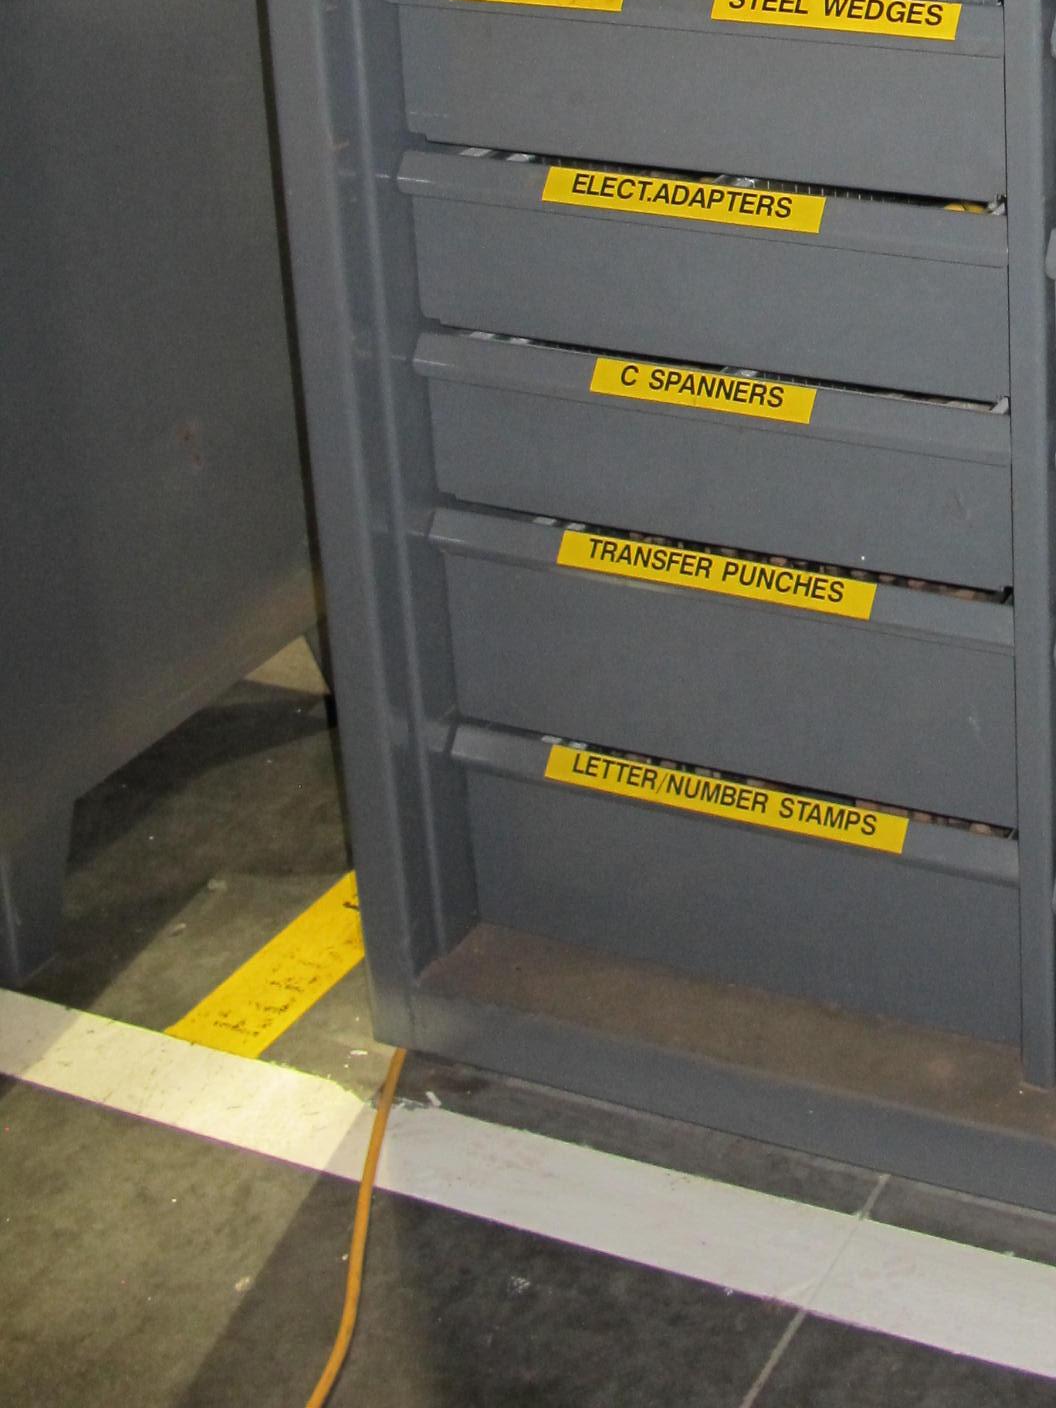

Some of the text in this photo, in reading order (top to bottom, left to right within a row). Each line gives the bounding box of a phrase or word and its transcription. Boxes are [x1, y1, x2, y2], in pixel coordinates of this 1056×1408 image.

[620, 364, 785, 410] C SPANNERS
[588, 538, 846, 604] TRANSFER PUNCHES
[572, 752, 877, 836] LETTER/NUMBER STAMPS
